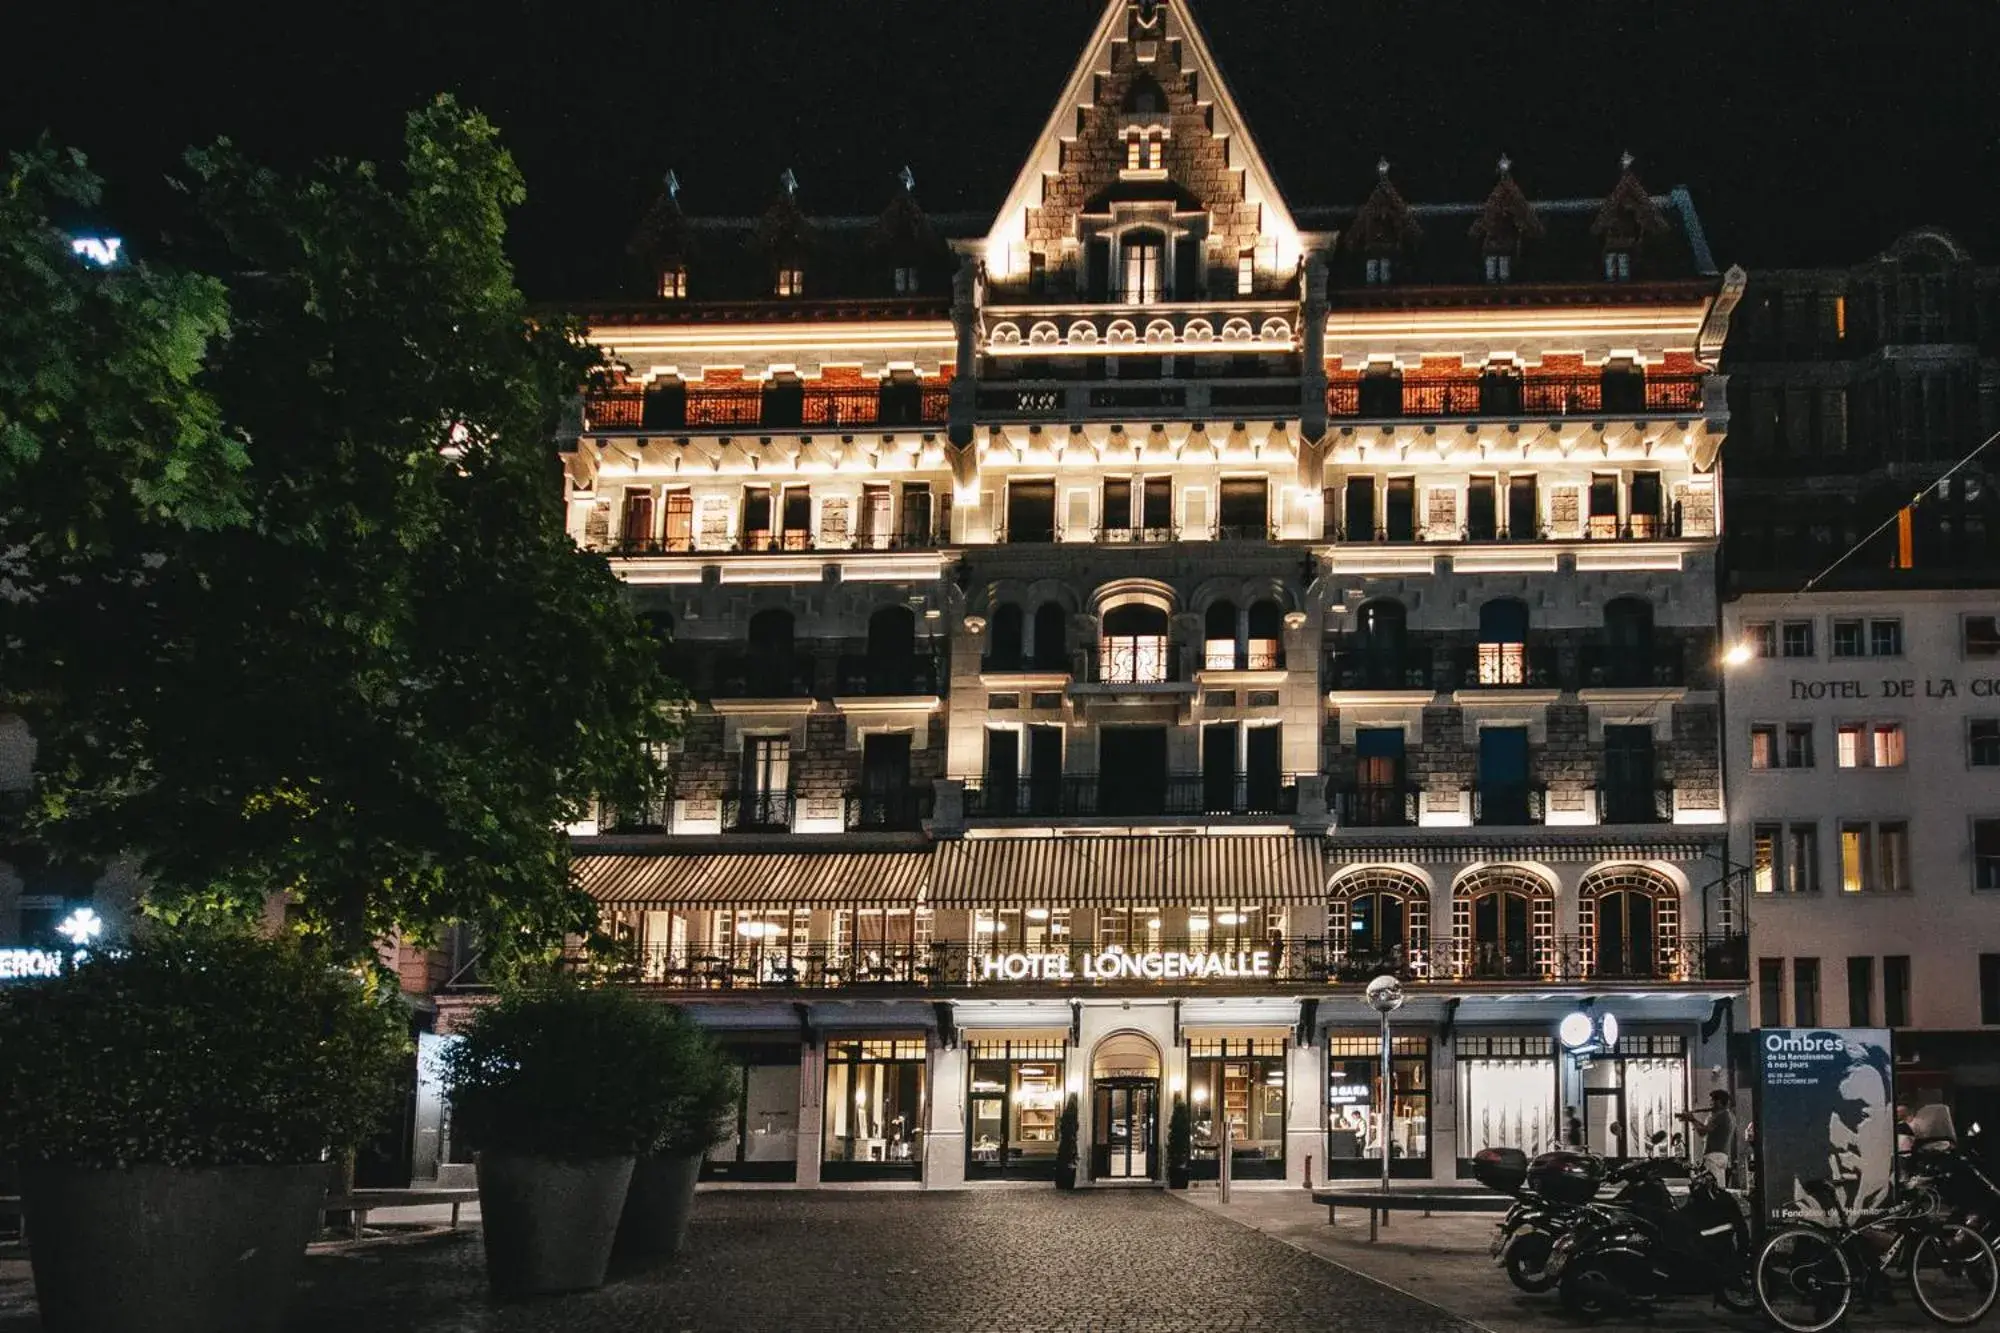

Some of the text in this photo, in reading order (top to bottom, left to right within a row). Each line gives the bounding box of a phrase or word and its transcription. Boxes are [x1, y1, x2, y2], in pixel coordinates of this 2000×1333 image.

[1882, 679, 1915, 698] DE
[1925, 679, 1958, 699] LA
[982, 952, 1075, 979] HOTEL
[1766, 1035, 1843, 1051] Ombres
